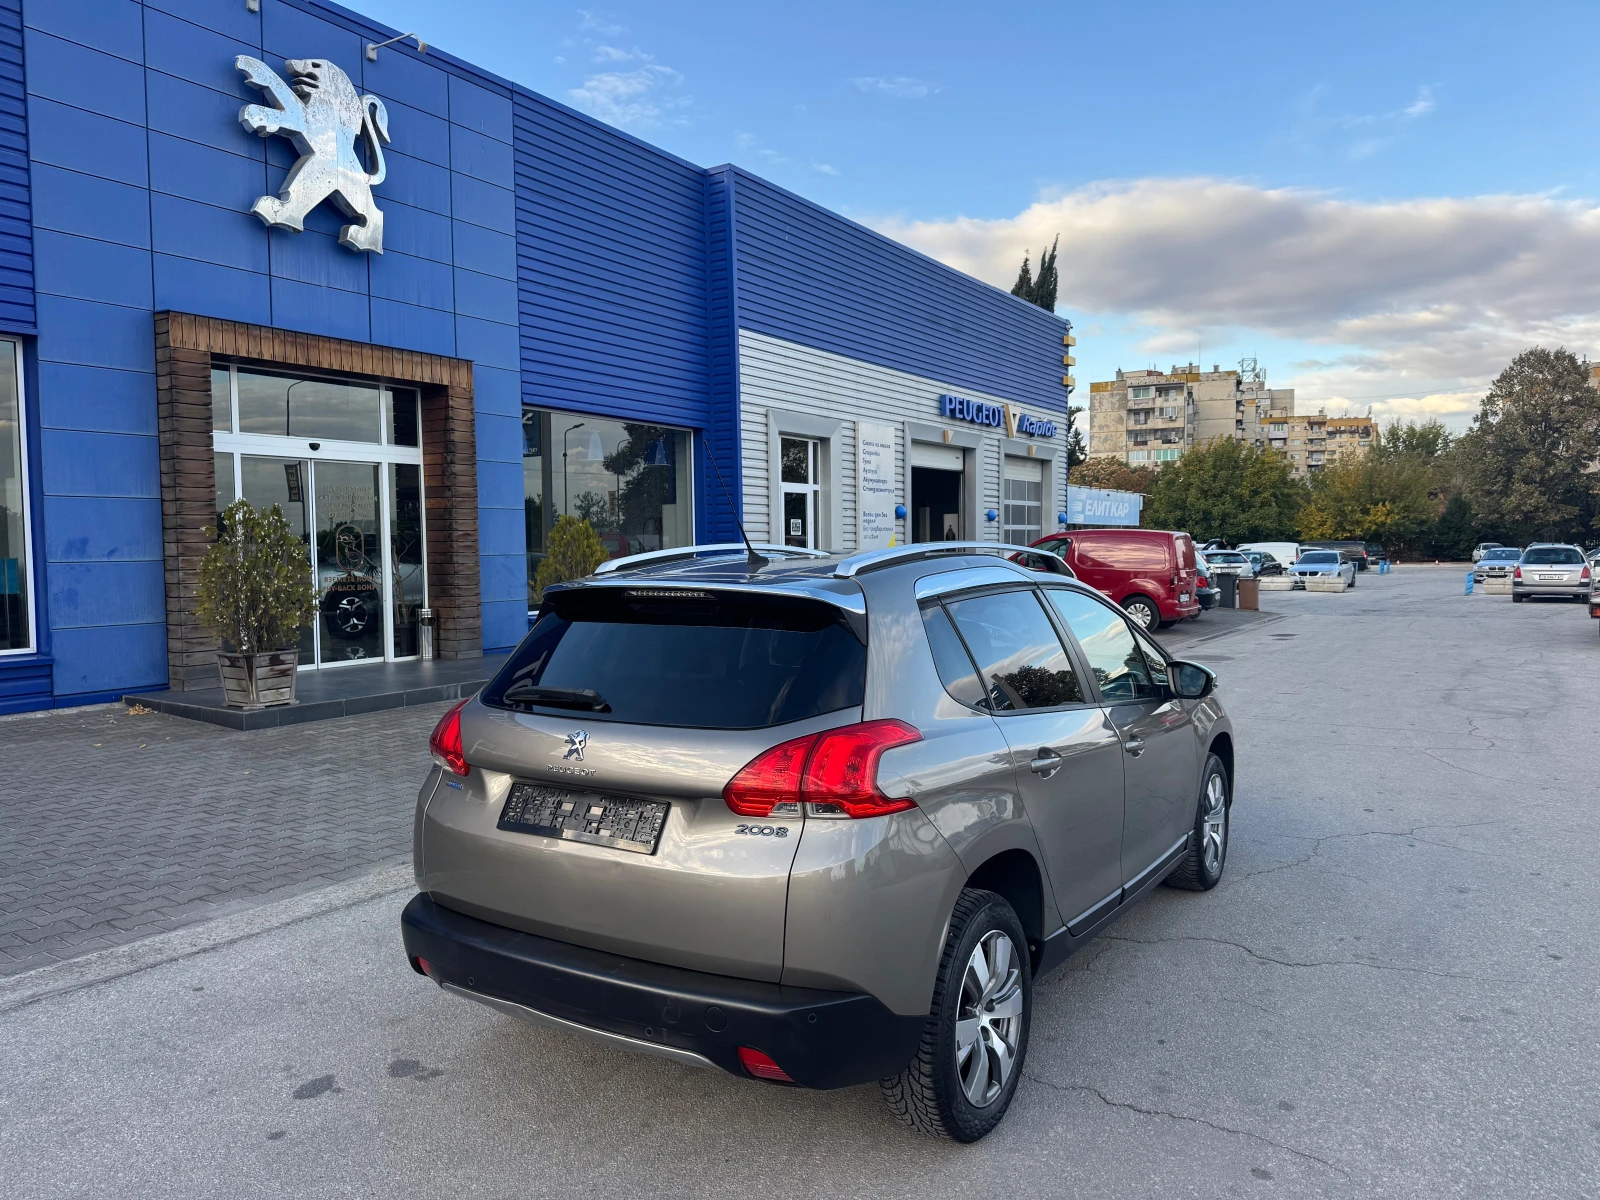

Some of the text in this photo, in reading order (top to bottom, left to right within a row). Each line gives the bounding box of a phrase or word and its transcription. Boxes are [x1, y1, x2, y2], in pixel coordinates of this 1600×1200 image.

[941, 394, 1004, 428] PEUGEOT
[545, 763, 597, 777] PEUGEOT
[735, 823, 790, 838] 2008
